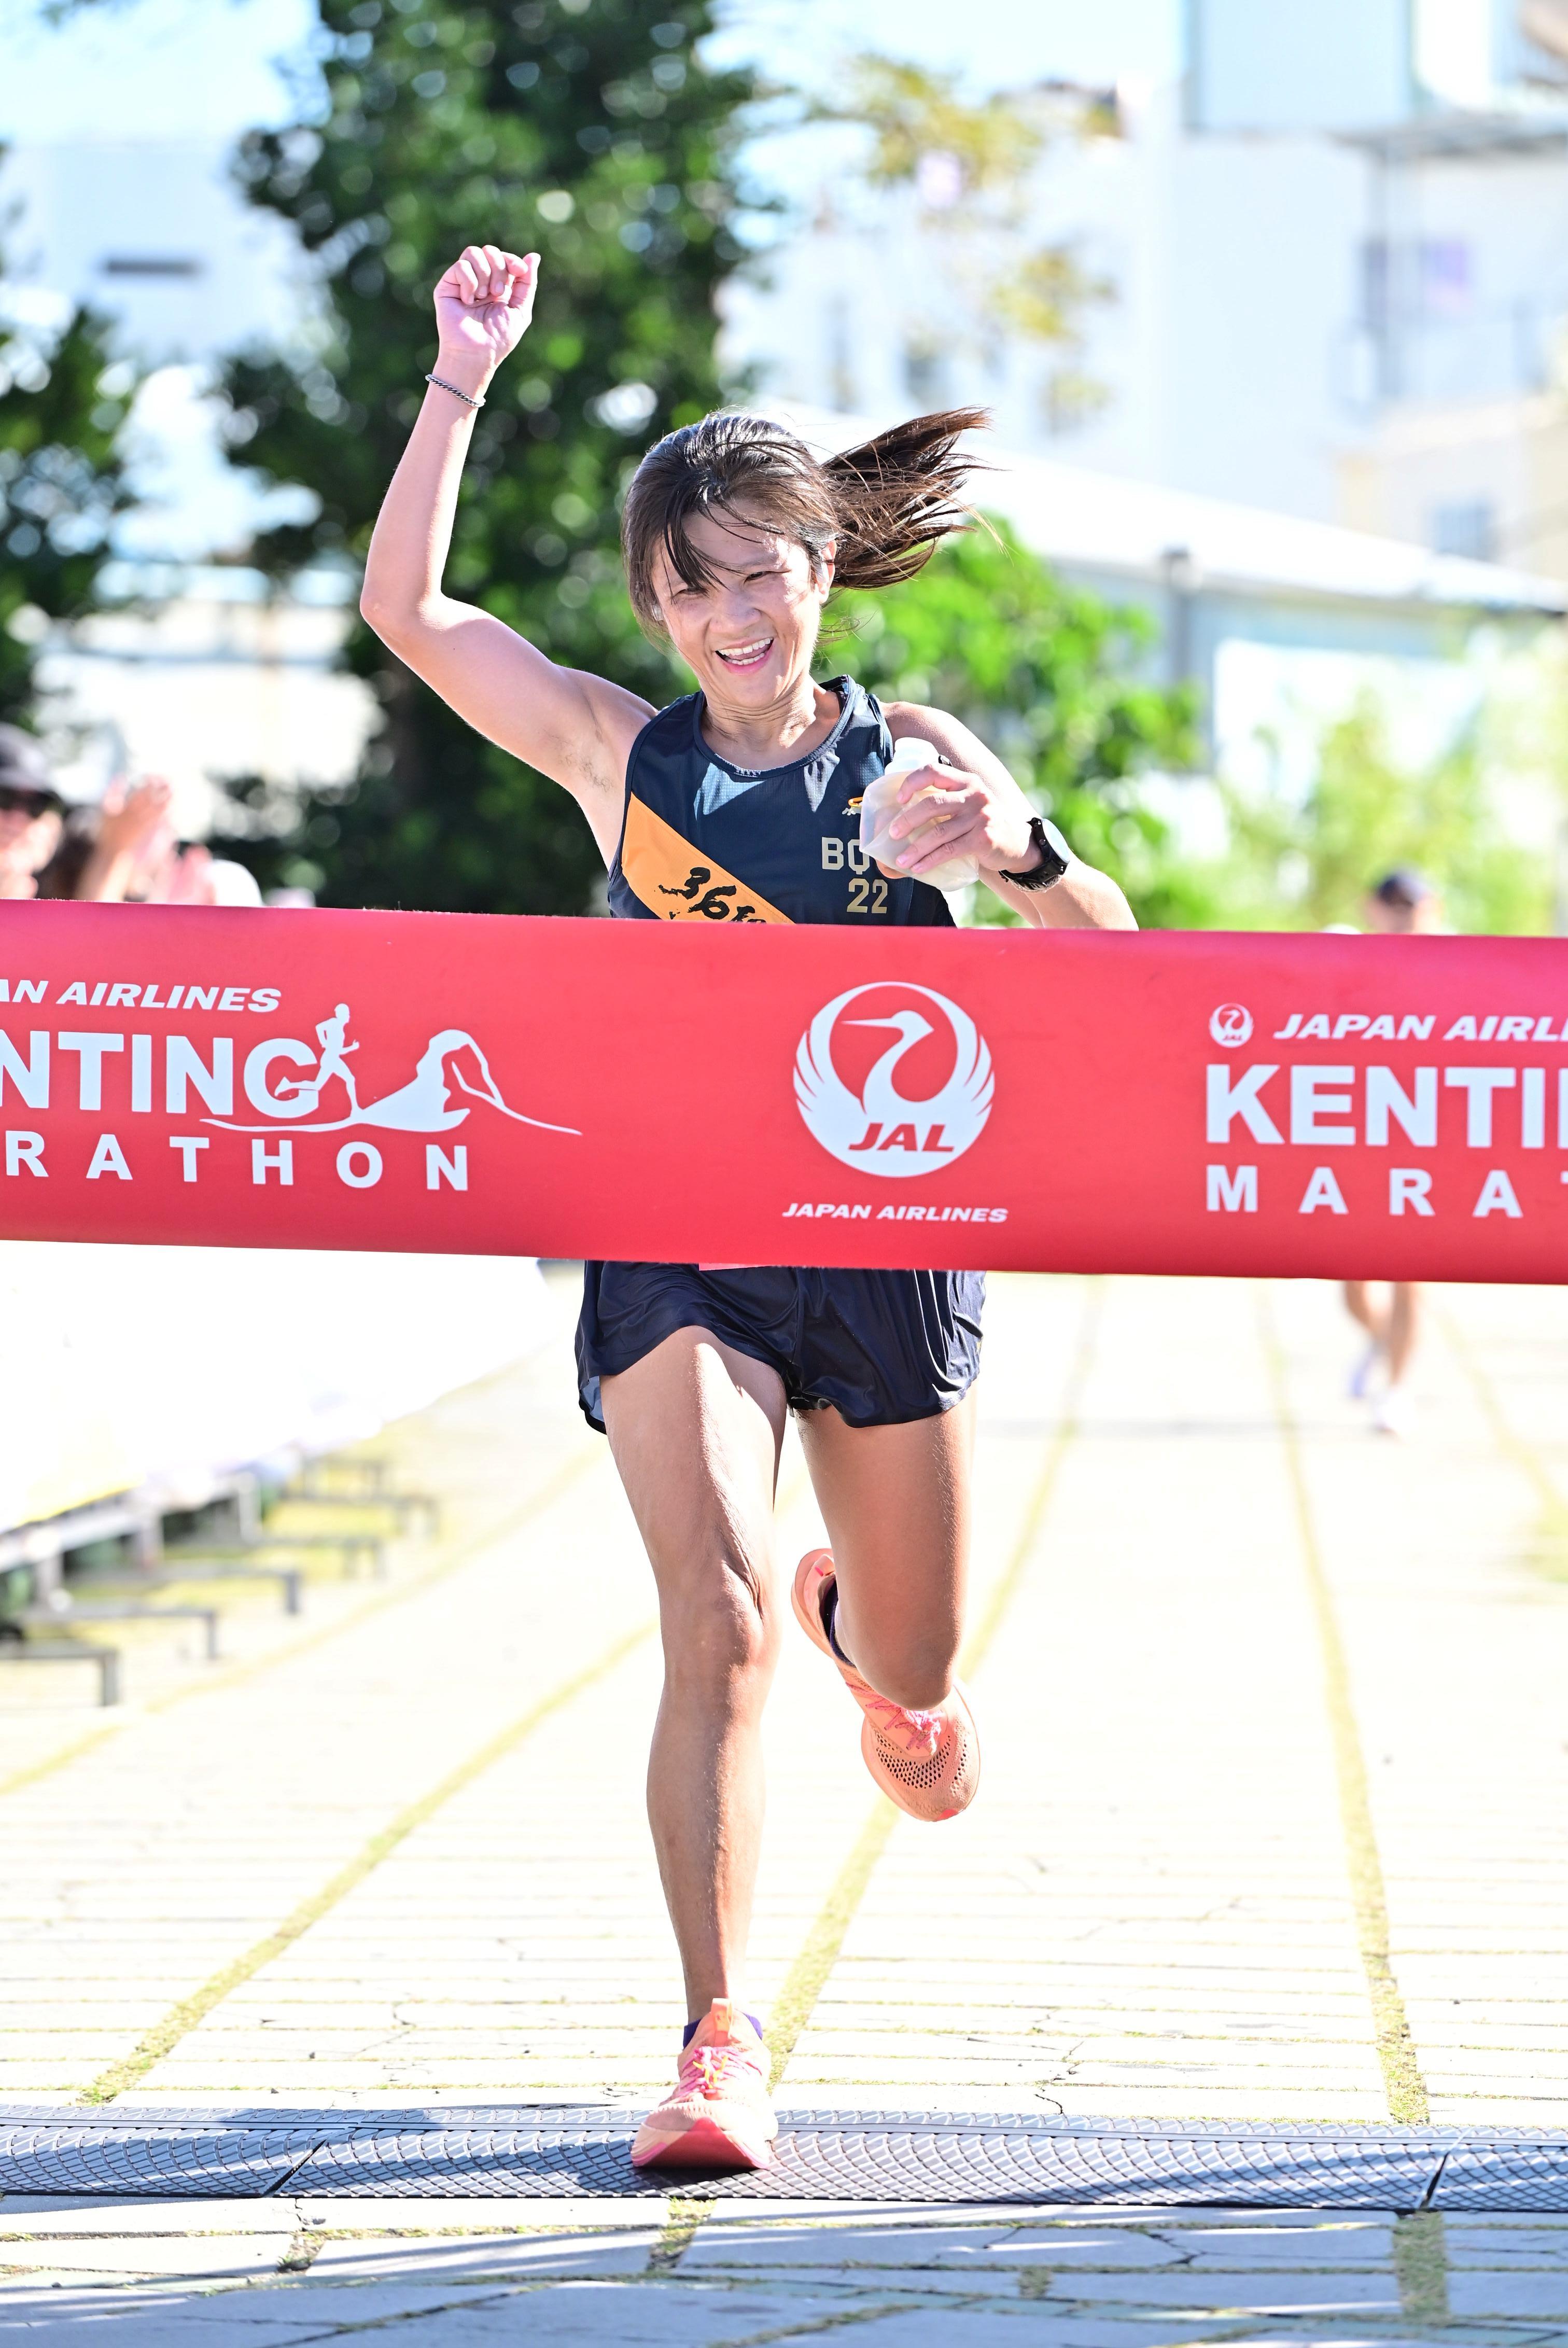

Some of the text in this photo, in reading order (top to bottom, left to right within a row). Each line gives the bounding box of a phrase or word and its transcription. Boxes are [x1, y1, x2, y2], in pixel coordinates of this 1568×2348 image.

[846, 878, 888, 914] 22
[55, 982, 282, 1012] AIRLINES
[1273, 1014, 1436, 1040] JAPAN
[0, 1029, 320, 1119] NTING
[1206, 1064, 1568, 1149] KENTI
[848, 1122, 955, 1153] JAL
[5, 1130, 468, 1191] RATHON
[1206, 1165, 1568, 1218] MARA
[782, 1203, 1008, 1223] JAPAN AIRLINES
